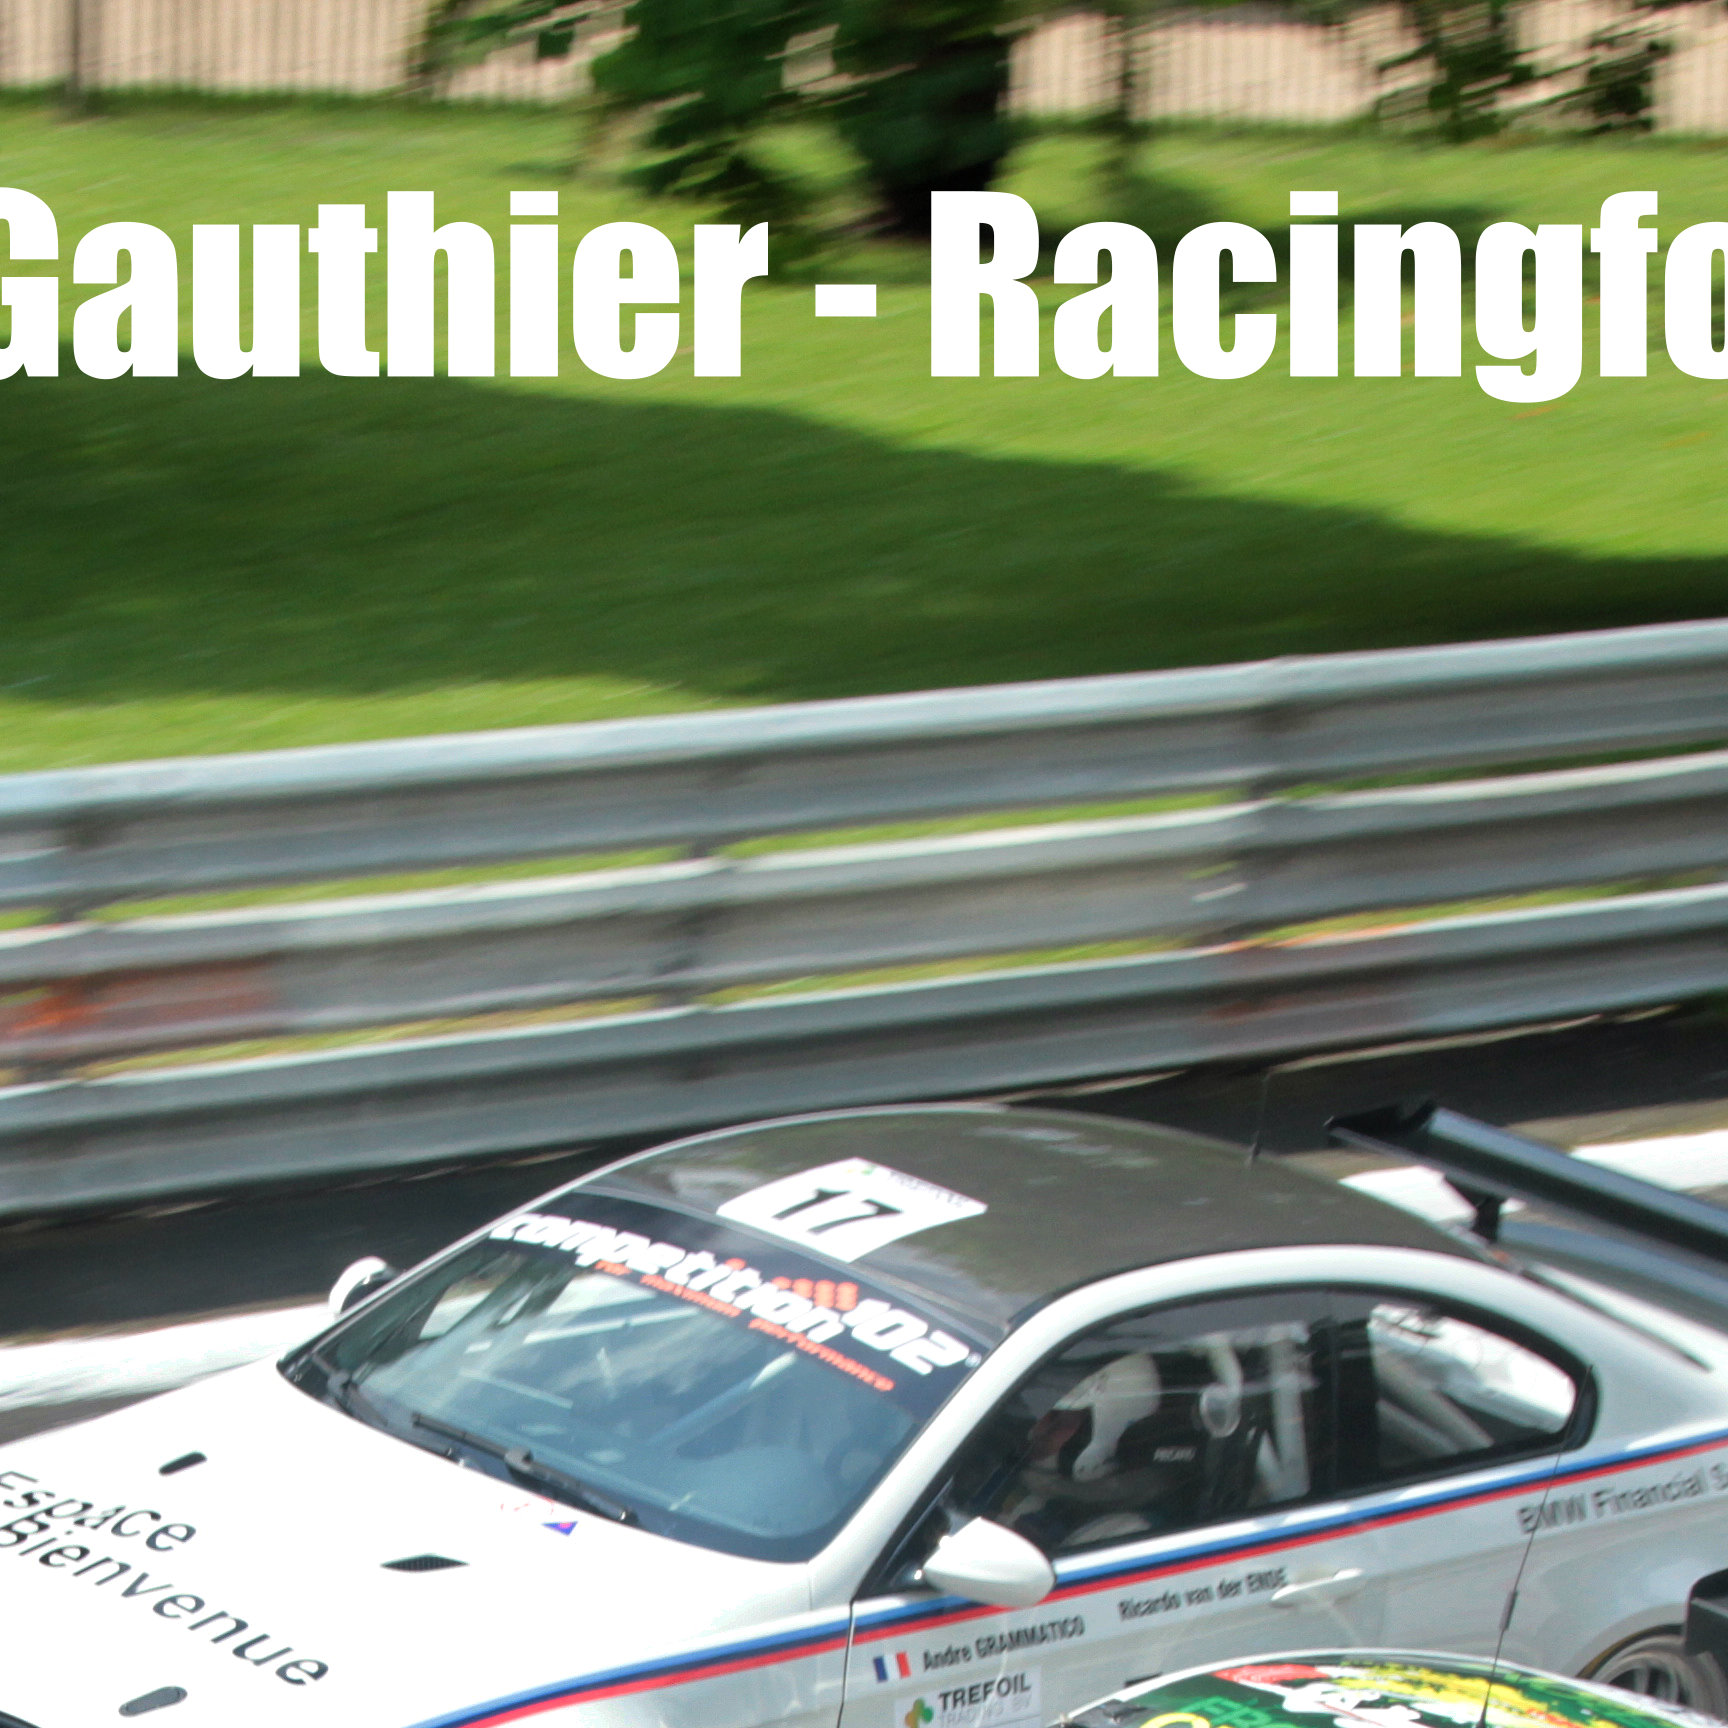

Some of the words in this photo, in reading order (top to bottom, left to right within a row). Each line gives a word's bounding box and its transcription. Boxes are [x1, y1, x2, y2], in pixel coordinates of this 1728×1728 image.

[771, 1187, 905, 1236] 17
[1592, 1467, 1704, 1516] Financial
[939, 1673, 1032, 1711] TREFOIL
